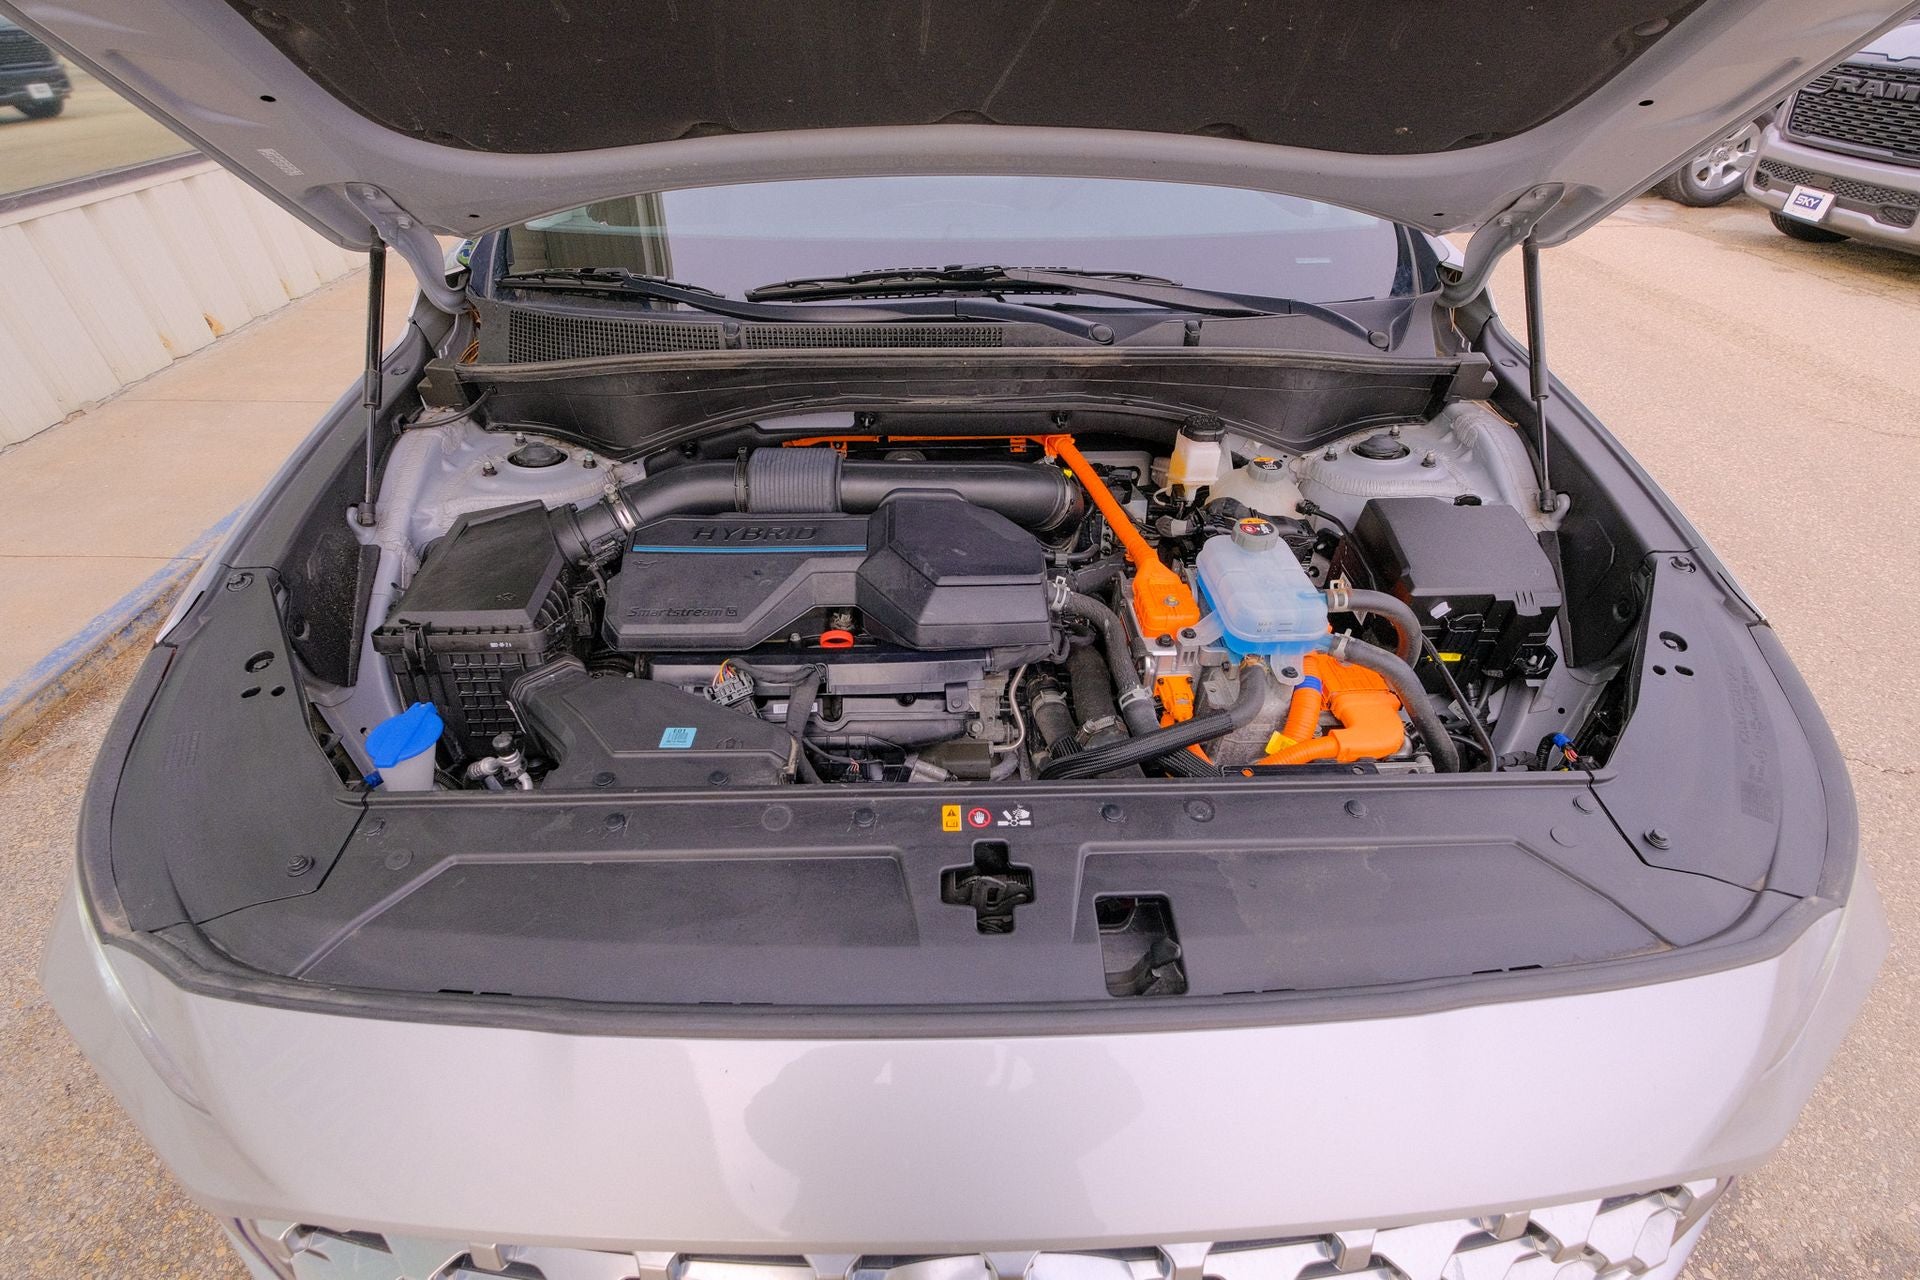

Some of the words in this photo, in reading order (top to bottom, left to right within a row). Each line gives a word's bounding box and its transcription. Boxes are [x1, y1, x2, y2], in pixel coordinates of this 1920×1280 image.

[1833, 76, 1920, 101] RAM
[1795, 195, 1820, 207] SKY
[692, 526, 818, 542] HYBRID
[627, 606, 723, 617] Smartstream
